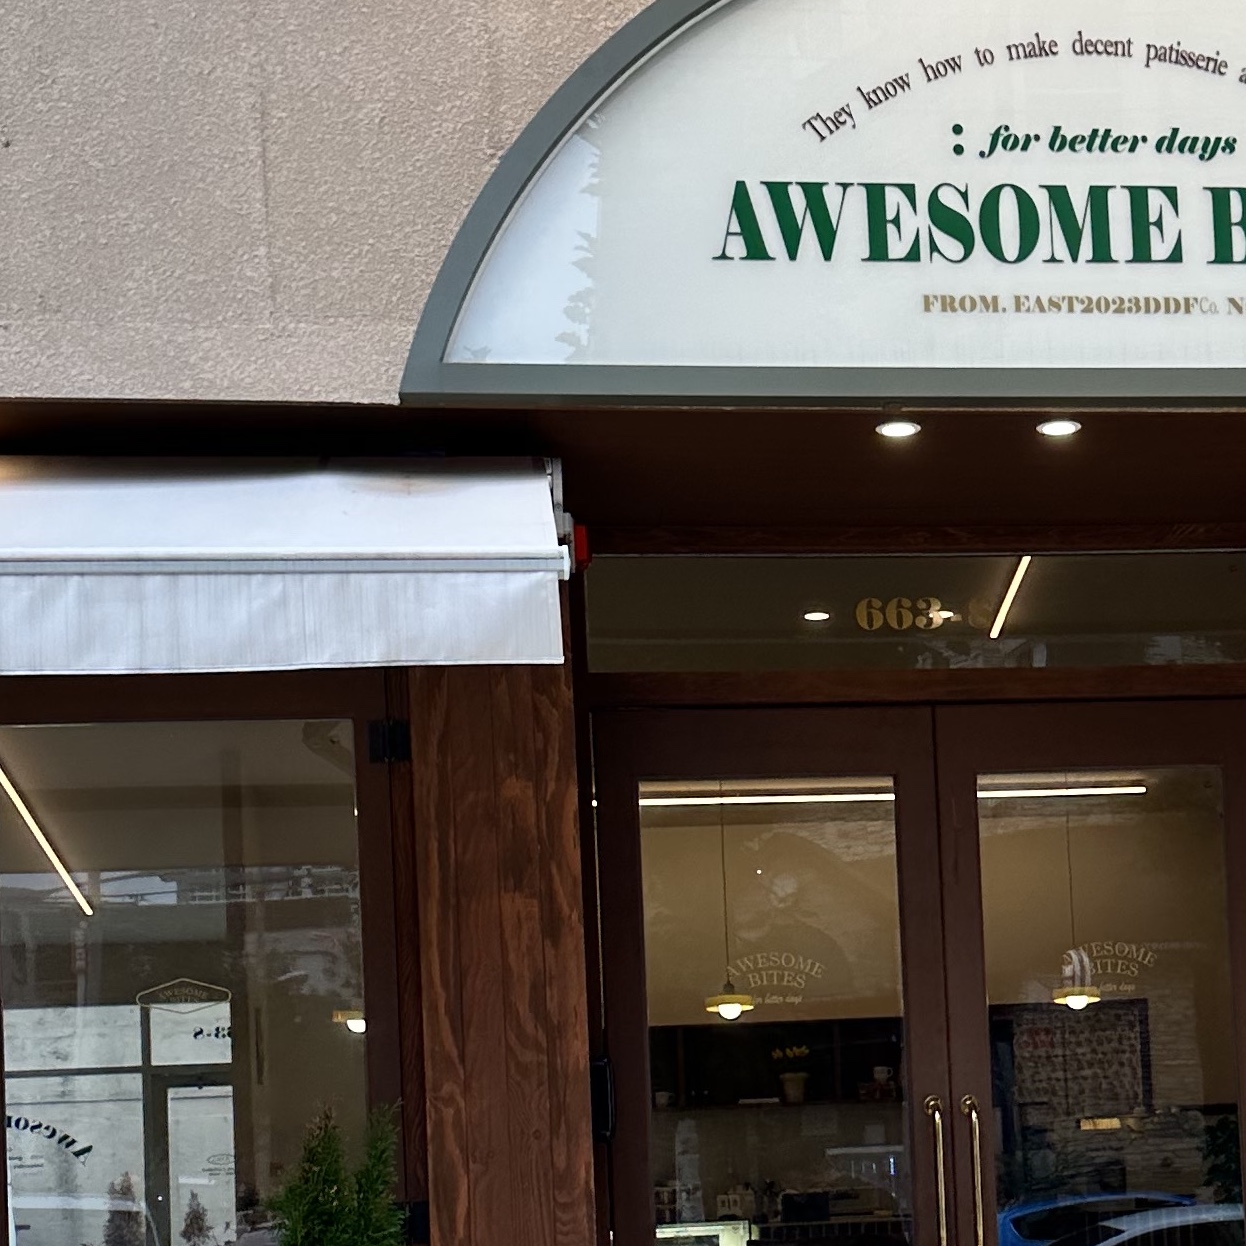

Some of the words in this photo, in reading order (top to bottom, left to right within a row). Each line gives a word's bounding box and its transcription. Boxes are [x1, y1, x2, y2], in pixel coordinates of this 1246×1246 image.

[801, 102, 857, 143] They
[856, 71, 913, 110] know
[917, 54, 964, 83] how
[973, 46, 996, 68] to
[1005, 31, 1060, 62] make
[1071, 30, 1135, 58] decent
[1143, 40, 1229, 76] patisserie
[978, 123, 1042, 160] for
[1047, 125, 1148, 154] better
[1154, 127, 1238, 162] days
[711, 179, 1184, 265] AWESOME
[921, 293, 1007, 314] FROM.
[726, 951, 827, 979] AWESOME
[747, 969, 808, 989] BITES
